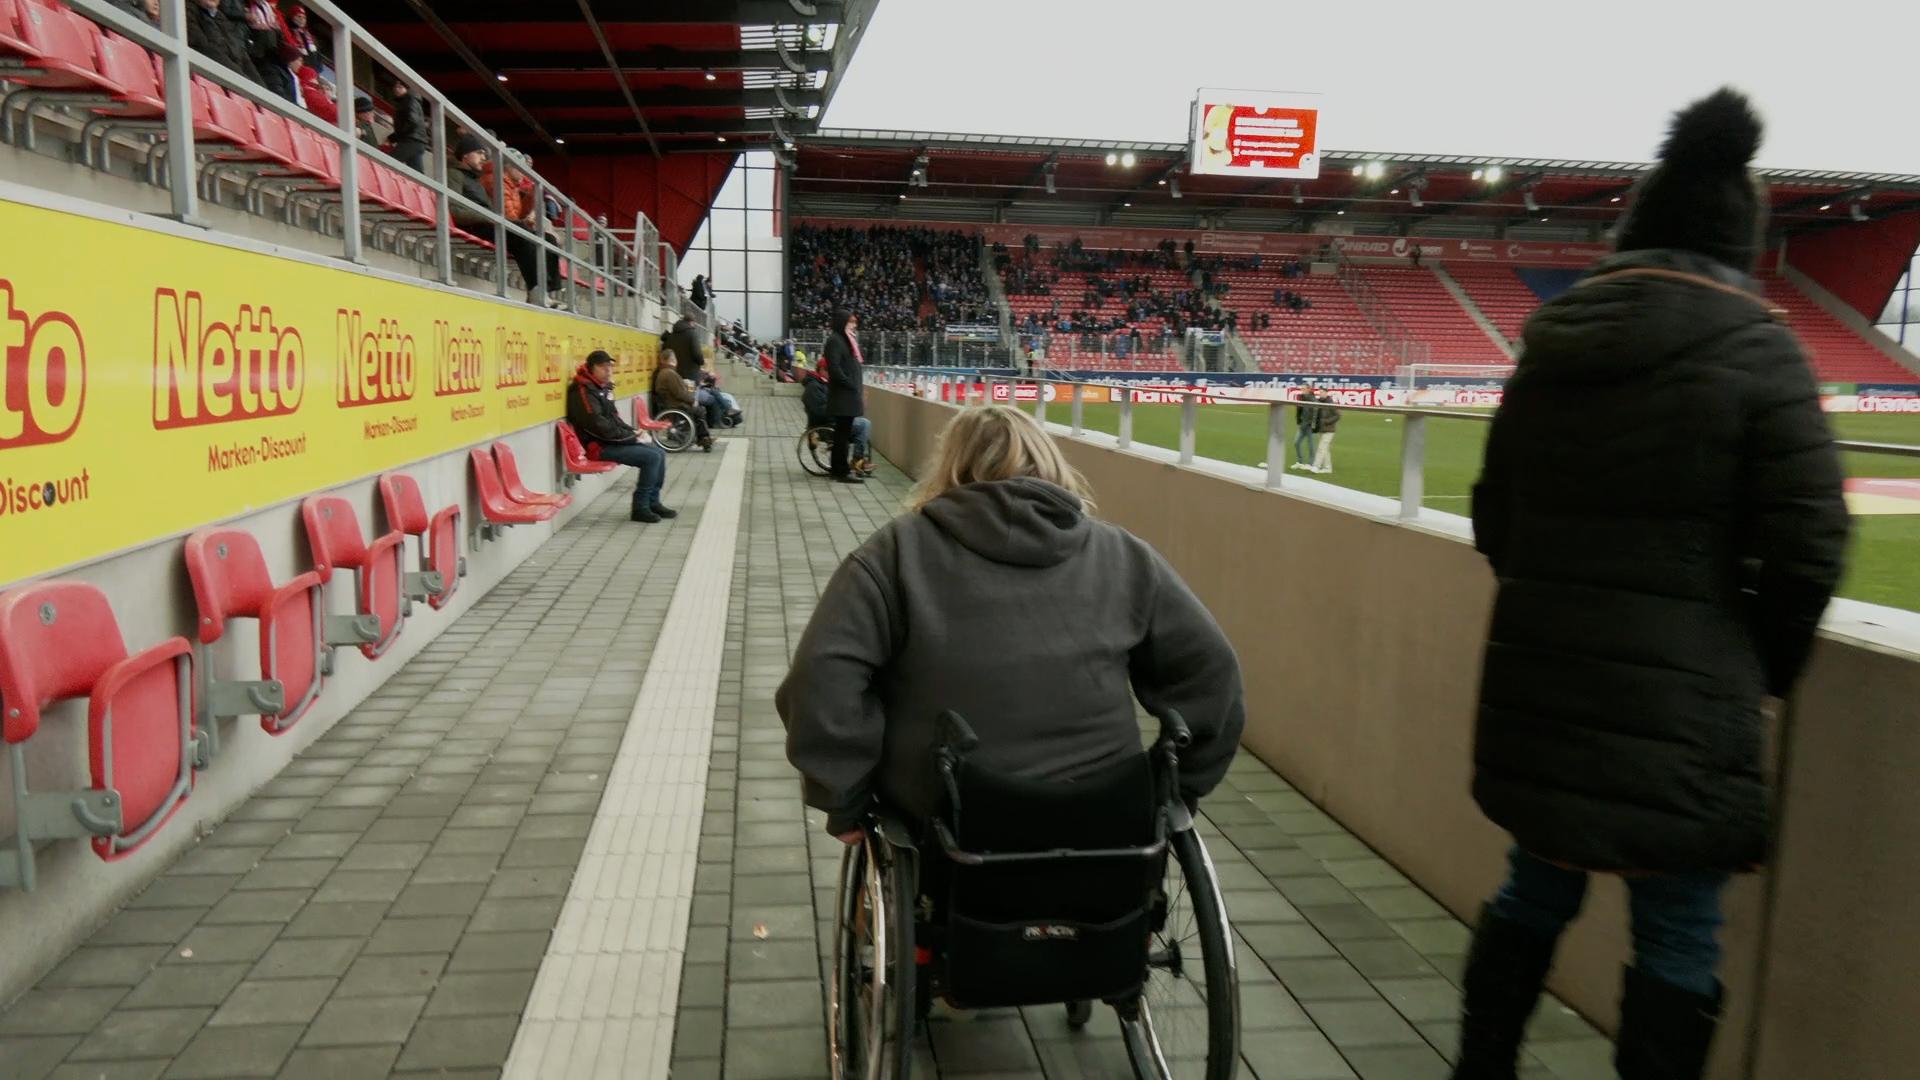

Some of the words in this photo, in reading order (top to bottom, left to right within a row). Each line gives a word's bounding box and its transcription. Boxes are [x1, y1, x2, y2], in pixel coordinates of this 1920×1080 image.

[152, 287, 304, 430] Netto
[337, 308, 416, 408] Netto
[434, 320, 483, 396] Netto
[208, 433, 306, 472] Marken-Discount
